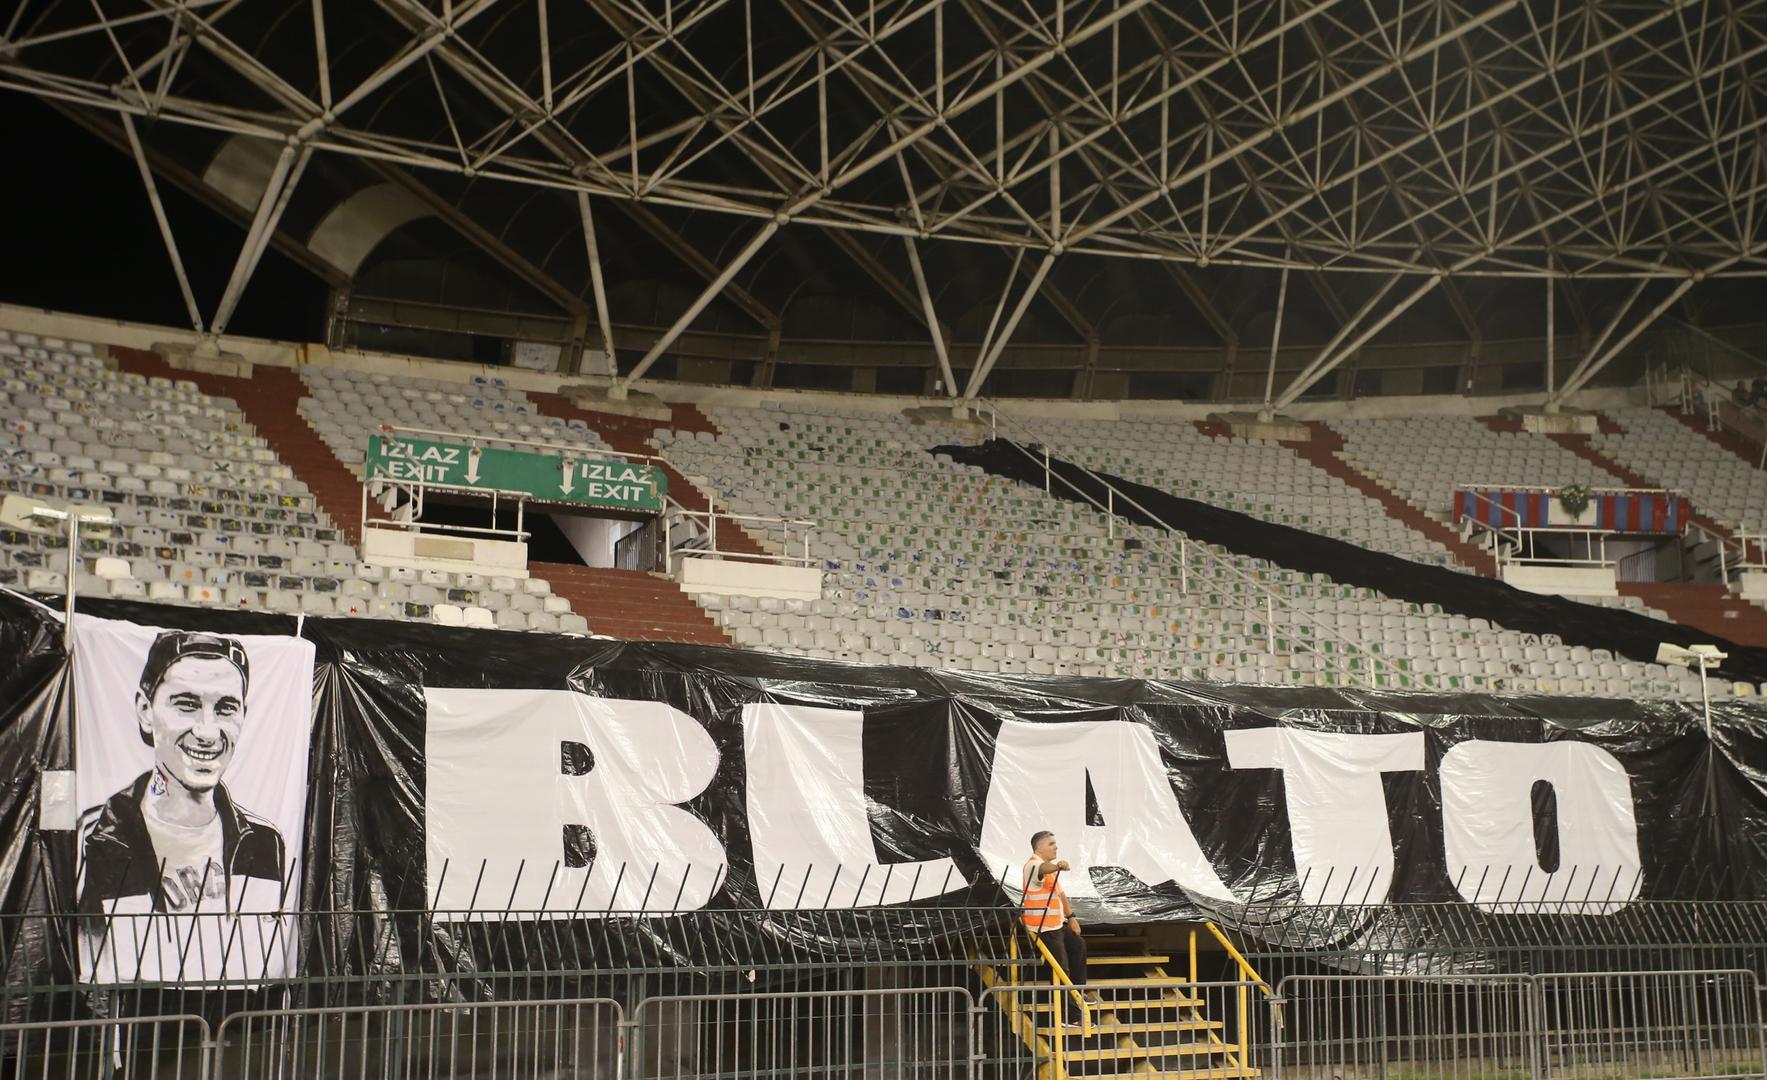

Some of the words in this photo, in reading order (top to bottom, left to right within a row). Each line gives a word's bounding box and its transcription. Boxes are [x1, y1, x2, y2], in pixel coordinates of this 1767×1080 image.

[381, 441, 460, 464] IZLAZ
[388, 461, 449, 482] EXIT
[581, 463, 653, 484] IZLAZ
[588, 482, 644, 502] EXIT
[423, 686, 1645, 922] BLATO
